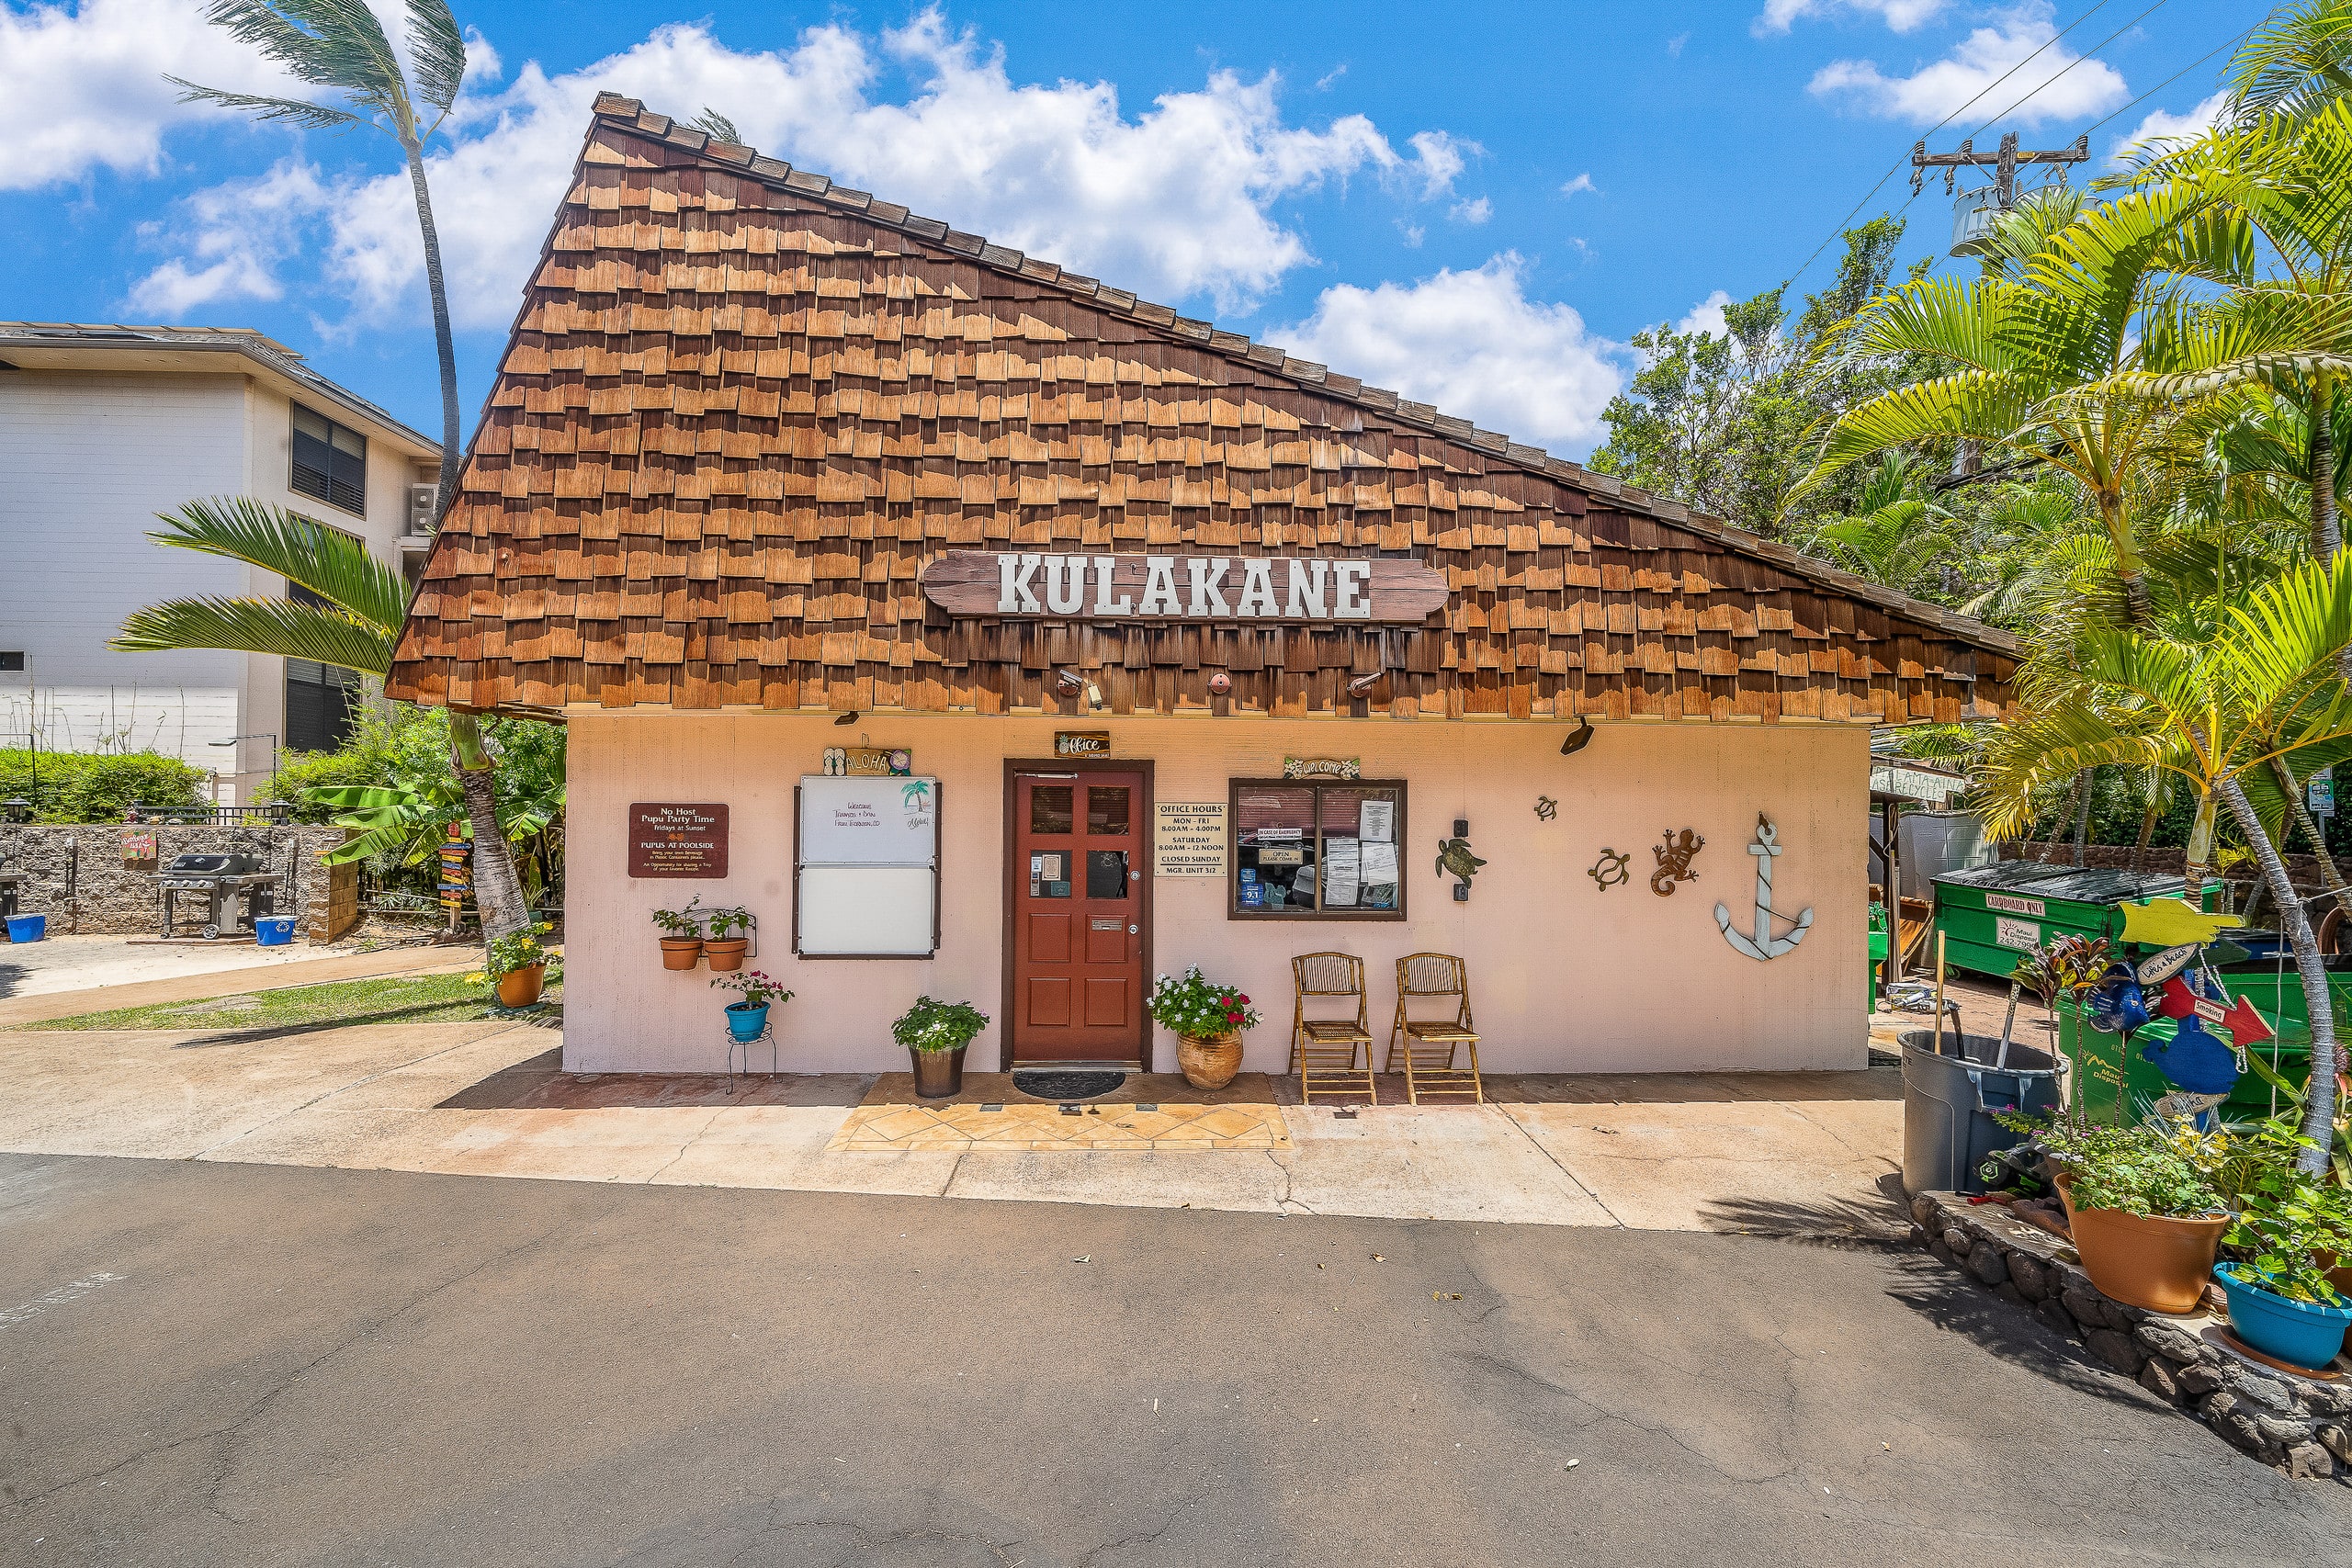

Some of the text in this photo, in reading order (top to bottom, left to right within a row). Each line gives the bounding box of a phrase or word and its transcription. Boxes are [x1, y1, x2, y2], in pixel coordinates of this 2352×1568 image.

[997, 553, 1371, 619] KULAKANE
[845, 753, 888, 773] ALOHA
[641, 815, 663, 824] Pupu
[667, 816, 690, 825] Party
[2009, 931, 2038, 942] Disposal
[2016, 929, 2033, 937] Maui
[2196, 1001, 2224, 1021] Smoking
